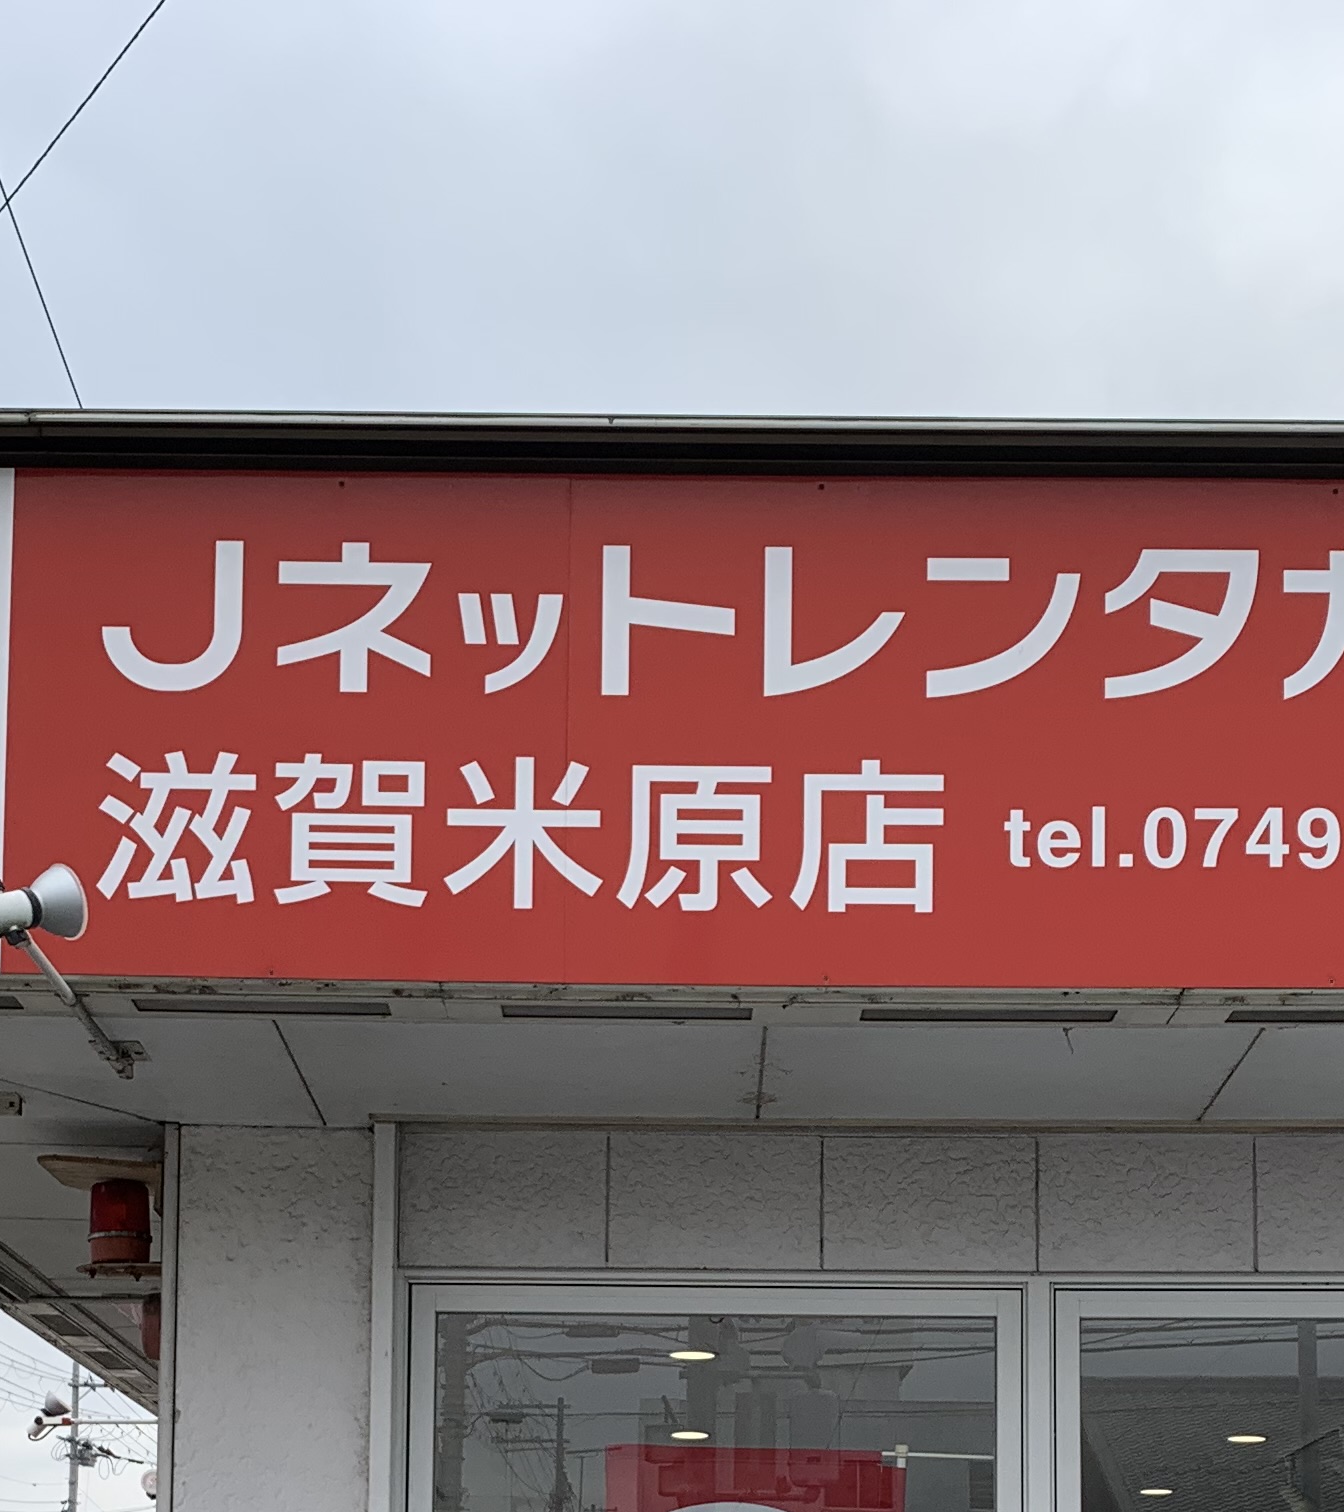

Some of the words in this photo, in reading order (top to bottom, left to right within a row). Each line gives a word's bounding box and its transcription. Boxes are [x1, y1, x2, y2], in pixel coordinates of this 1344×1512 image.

[97, 750, 945, 914] 滋賀米原店
